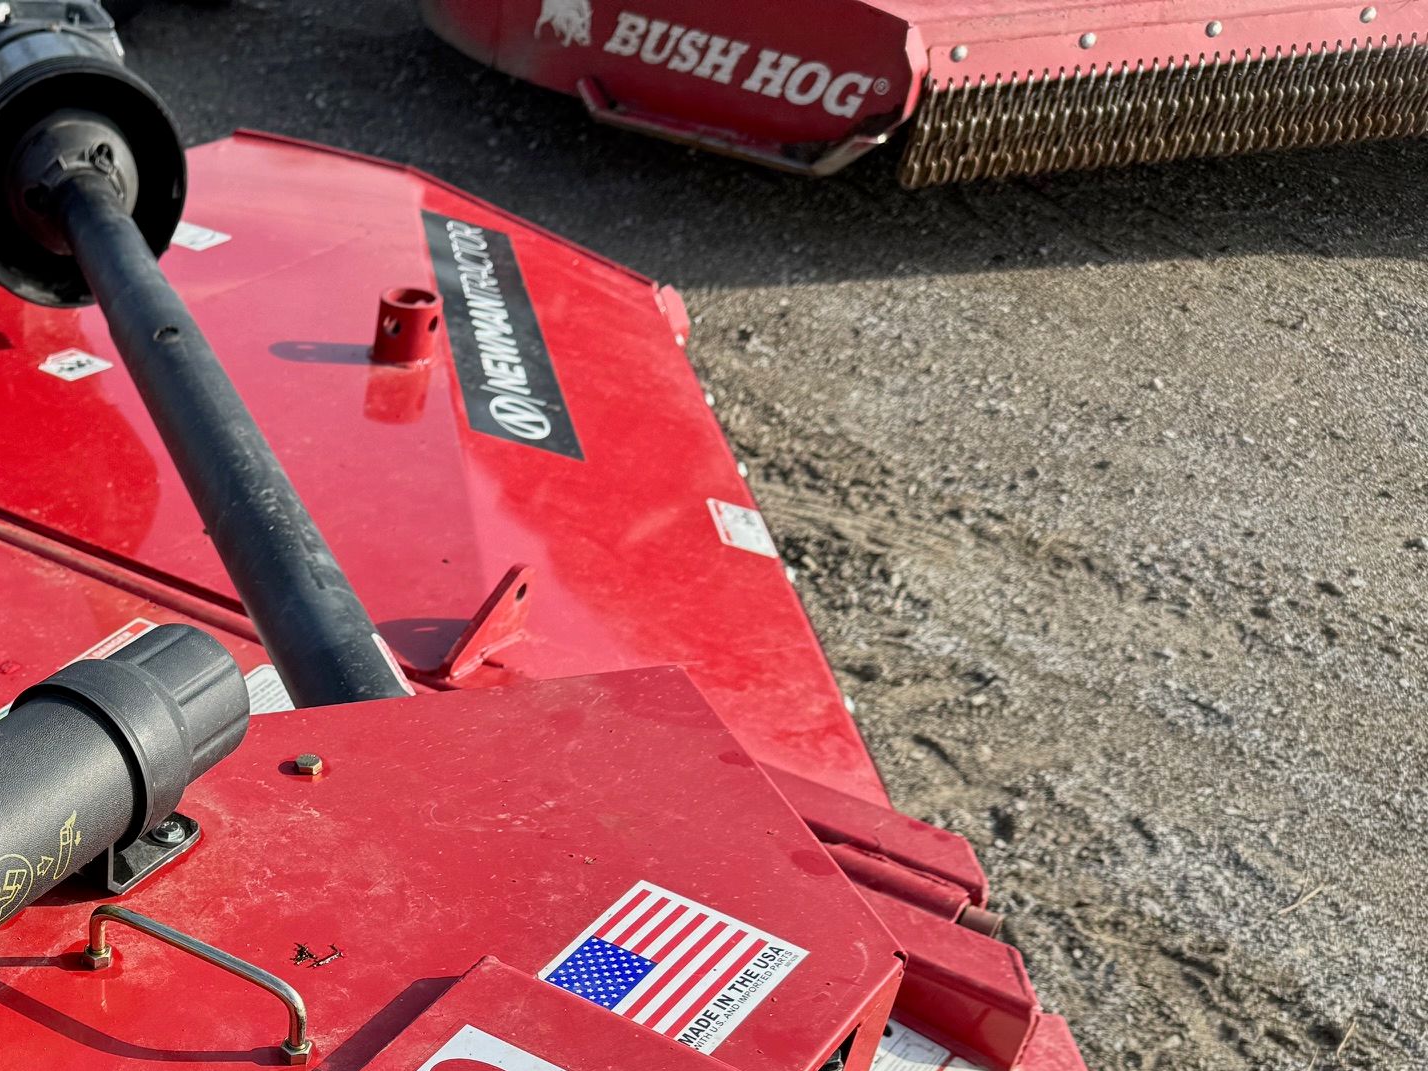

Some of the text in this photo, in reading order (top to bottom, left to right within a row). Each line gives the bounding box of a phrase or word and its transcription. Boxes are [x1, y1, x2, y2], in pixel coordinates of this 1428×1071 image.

[603, 12, 751, 84] BUSH
[677, 1009, 720, 1046] MADE
[713, 994, 735, 1011] IN
[727, 968, 760, 993] THE
[753, 946, 785, 969] USA
[694, 1032, 712, 1050] WITH
[710, 1020, 726, 1033] U.S.
[724, 1003, 740, 1019] AND
[738, 970, 773, 1004] IMPORTED
[770, 950, 793, 971] PARTS
